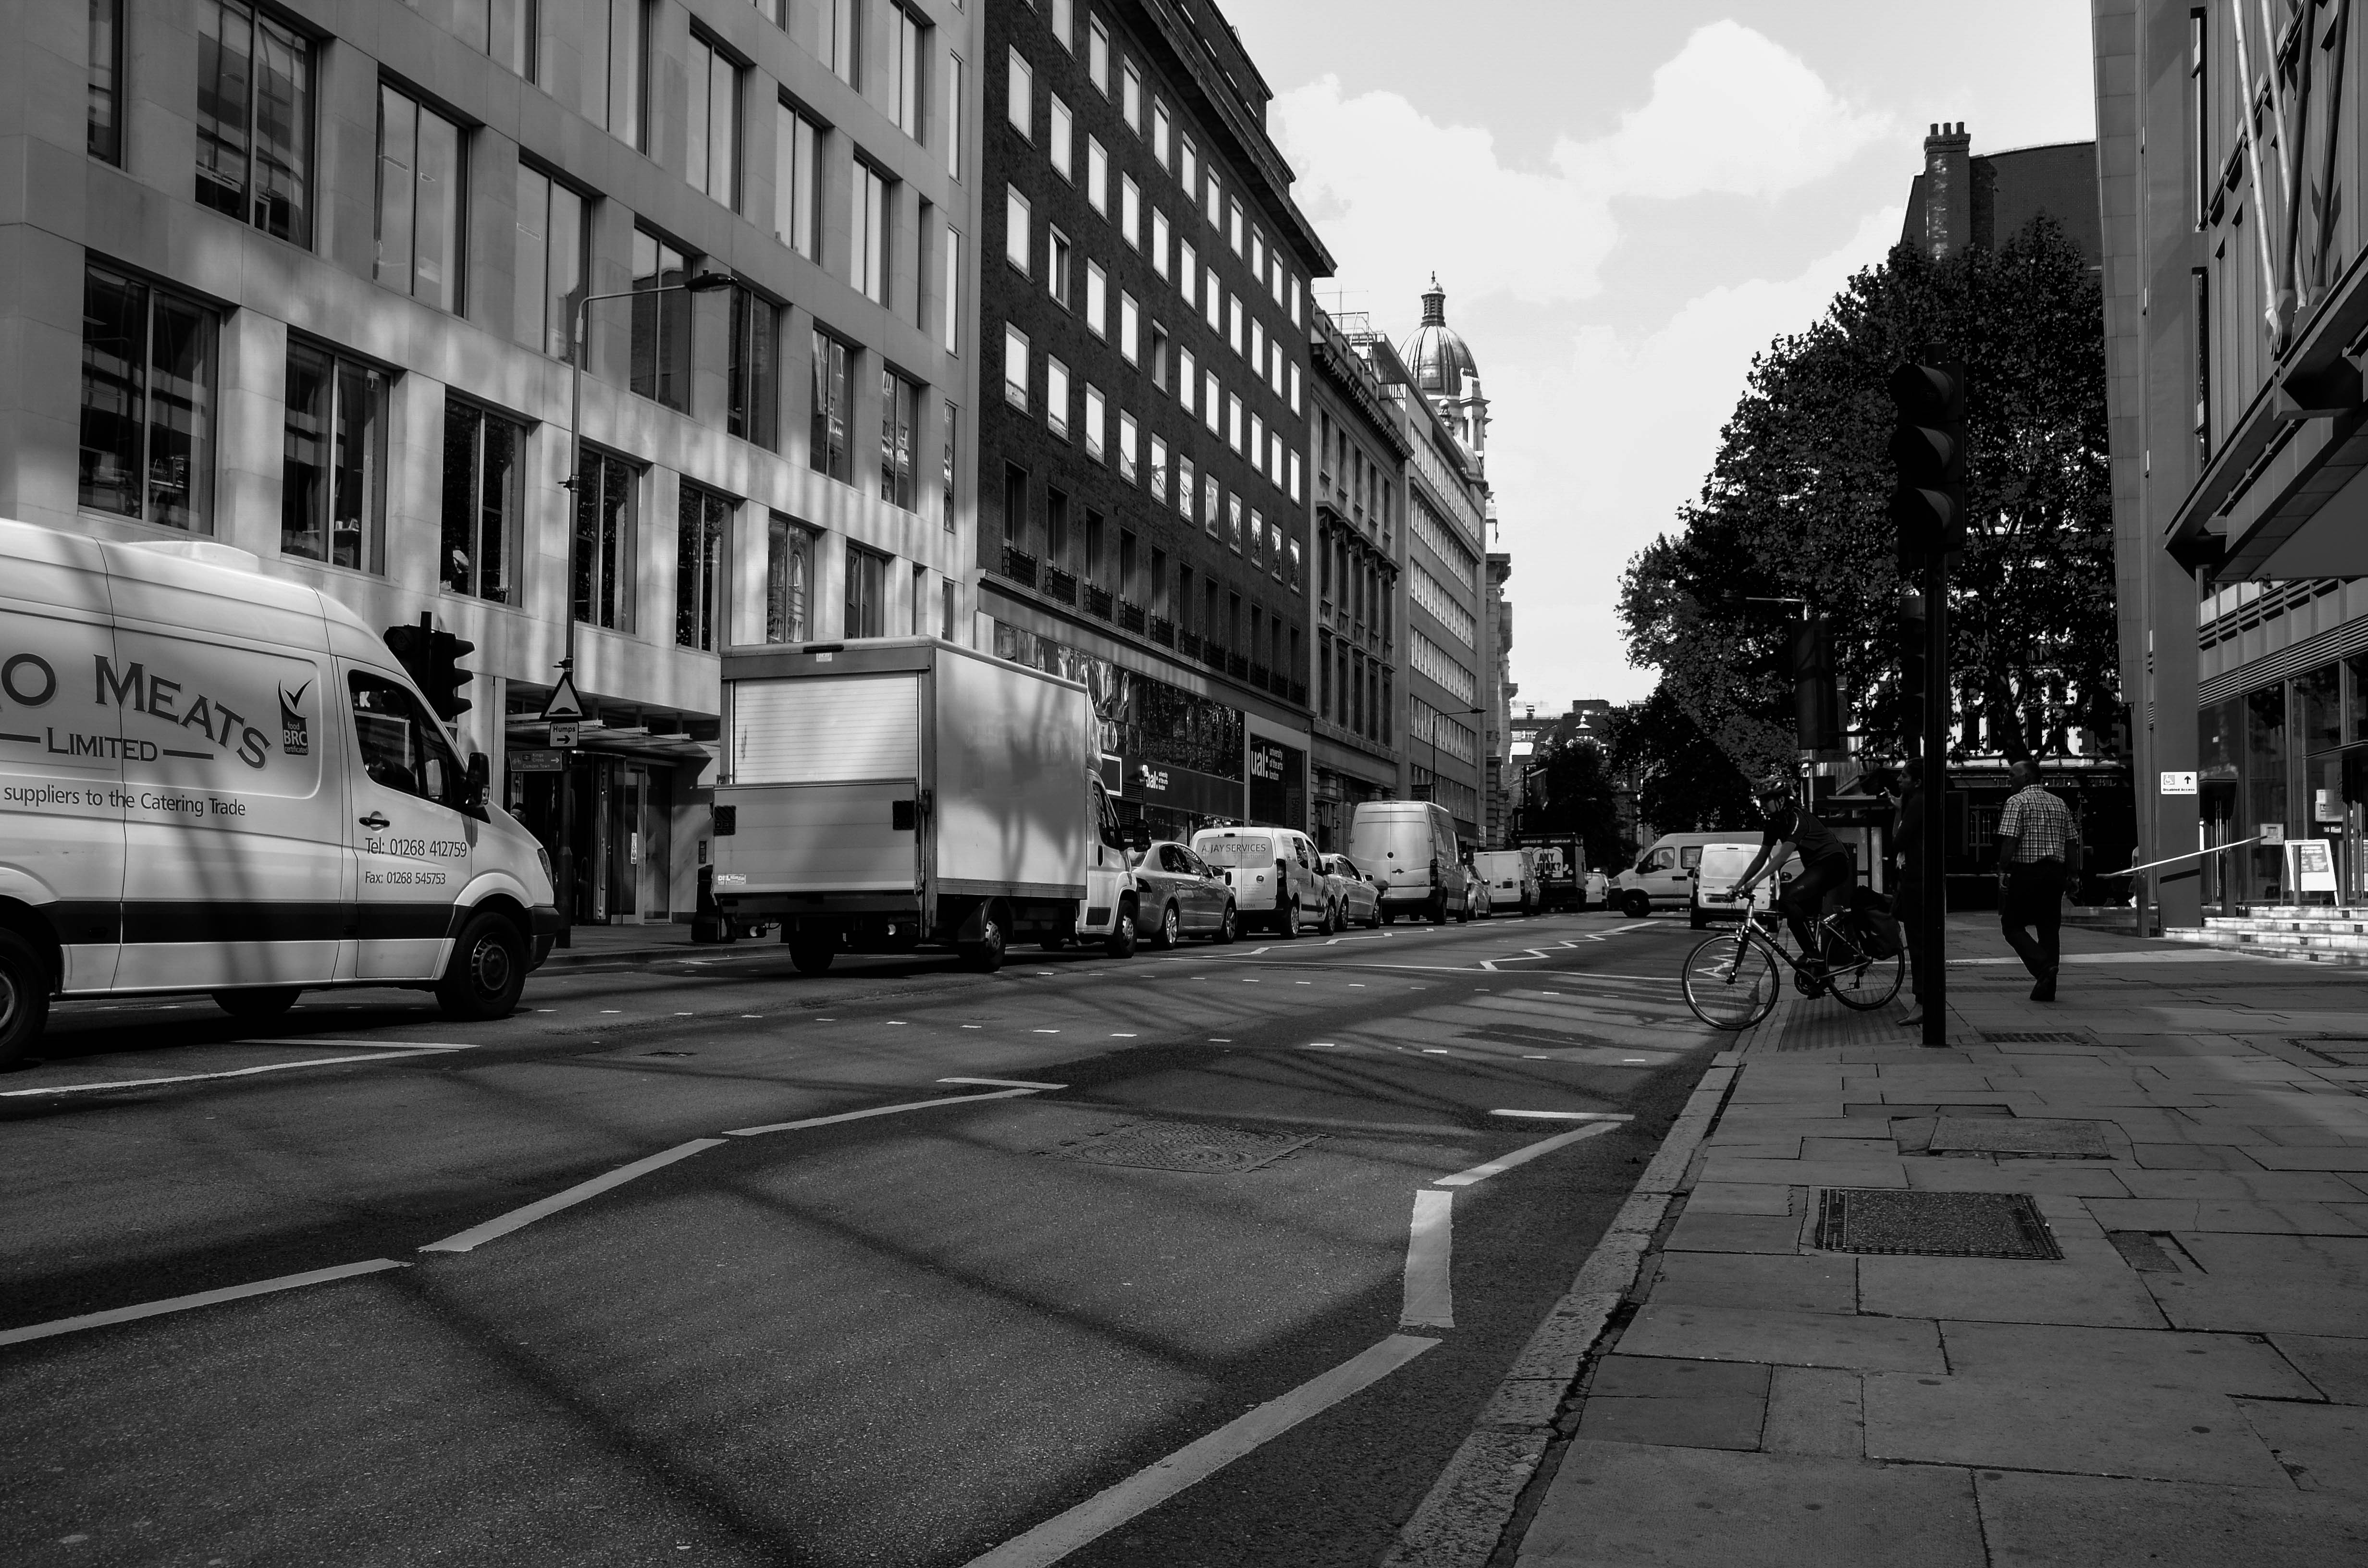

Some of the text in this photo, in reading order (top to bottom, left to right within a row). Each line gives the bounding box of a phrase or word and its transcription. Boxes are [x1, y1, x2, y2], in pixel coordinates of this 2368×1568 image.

[1, 653, 272, 769] O MEATS
[288, 722, 300, 730] food
[284, 730, 307, 746] BRC
[4, 784, 246, 817] suppliers to the Catering Trade
[365, 837, 467, 858] Tel: 01268 412759
[1226, 844, 1266, 852] SERVICES
[365, 871, 446, 885] Fax: 01268 545753
